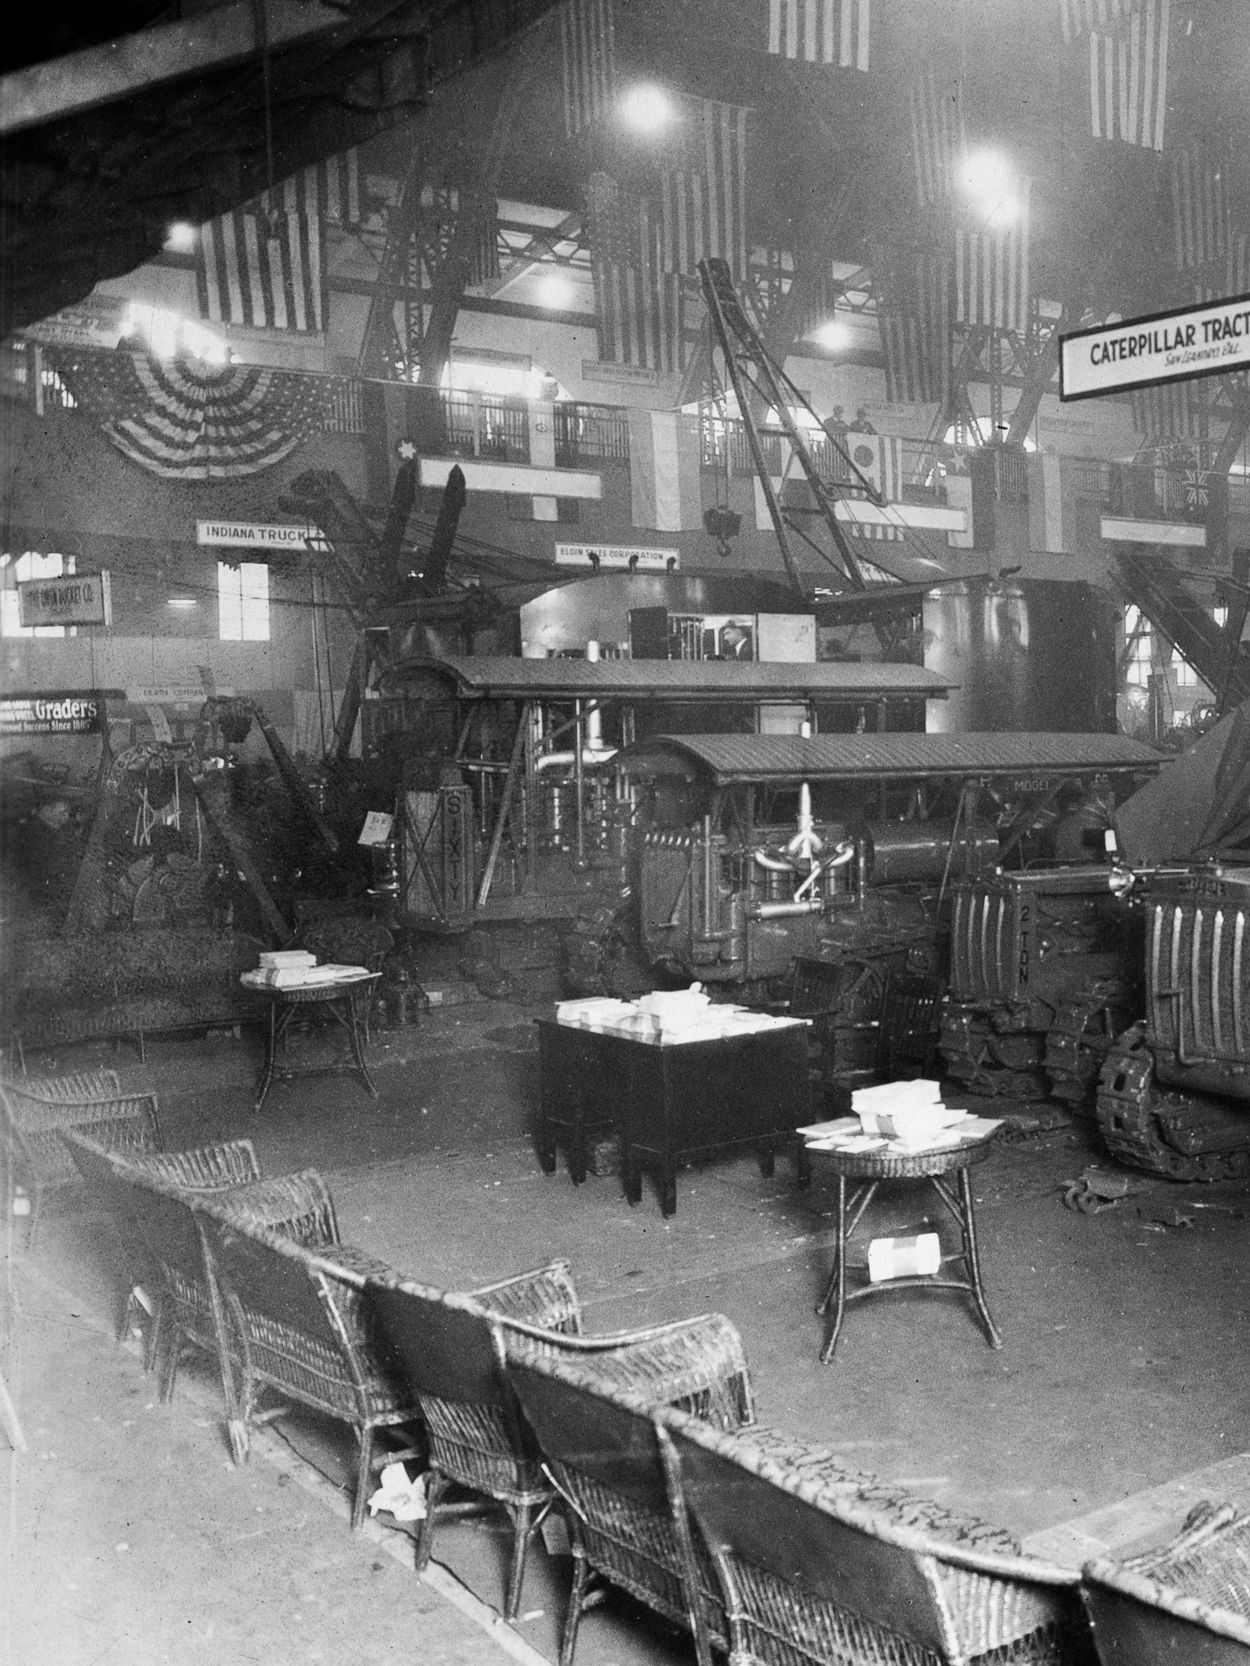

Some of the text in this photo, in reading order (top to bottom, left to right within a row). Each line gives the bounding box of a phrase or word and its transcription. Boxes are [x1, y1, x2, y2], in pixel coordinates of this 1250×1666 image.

[1090, 328, 1197, 365] CATERPILLAR
[206, 525, 306, 541] INDIANA TRUCK
[35, 698, 97, 720] Graders
[447, 795, 461, 901] SIXTY
[1020, 905, 1030, 922] 2
[1019, 930, 1030, 984] TON
